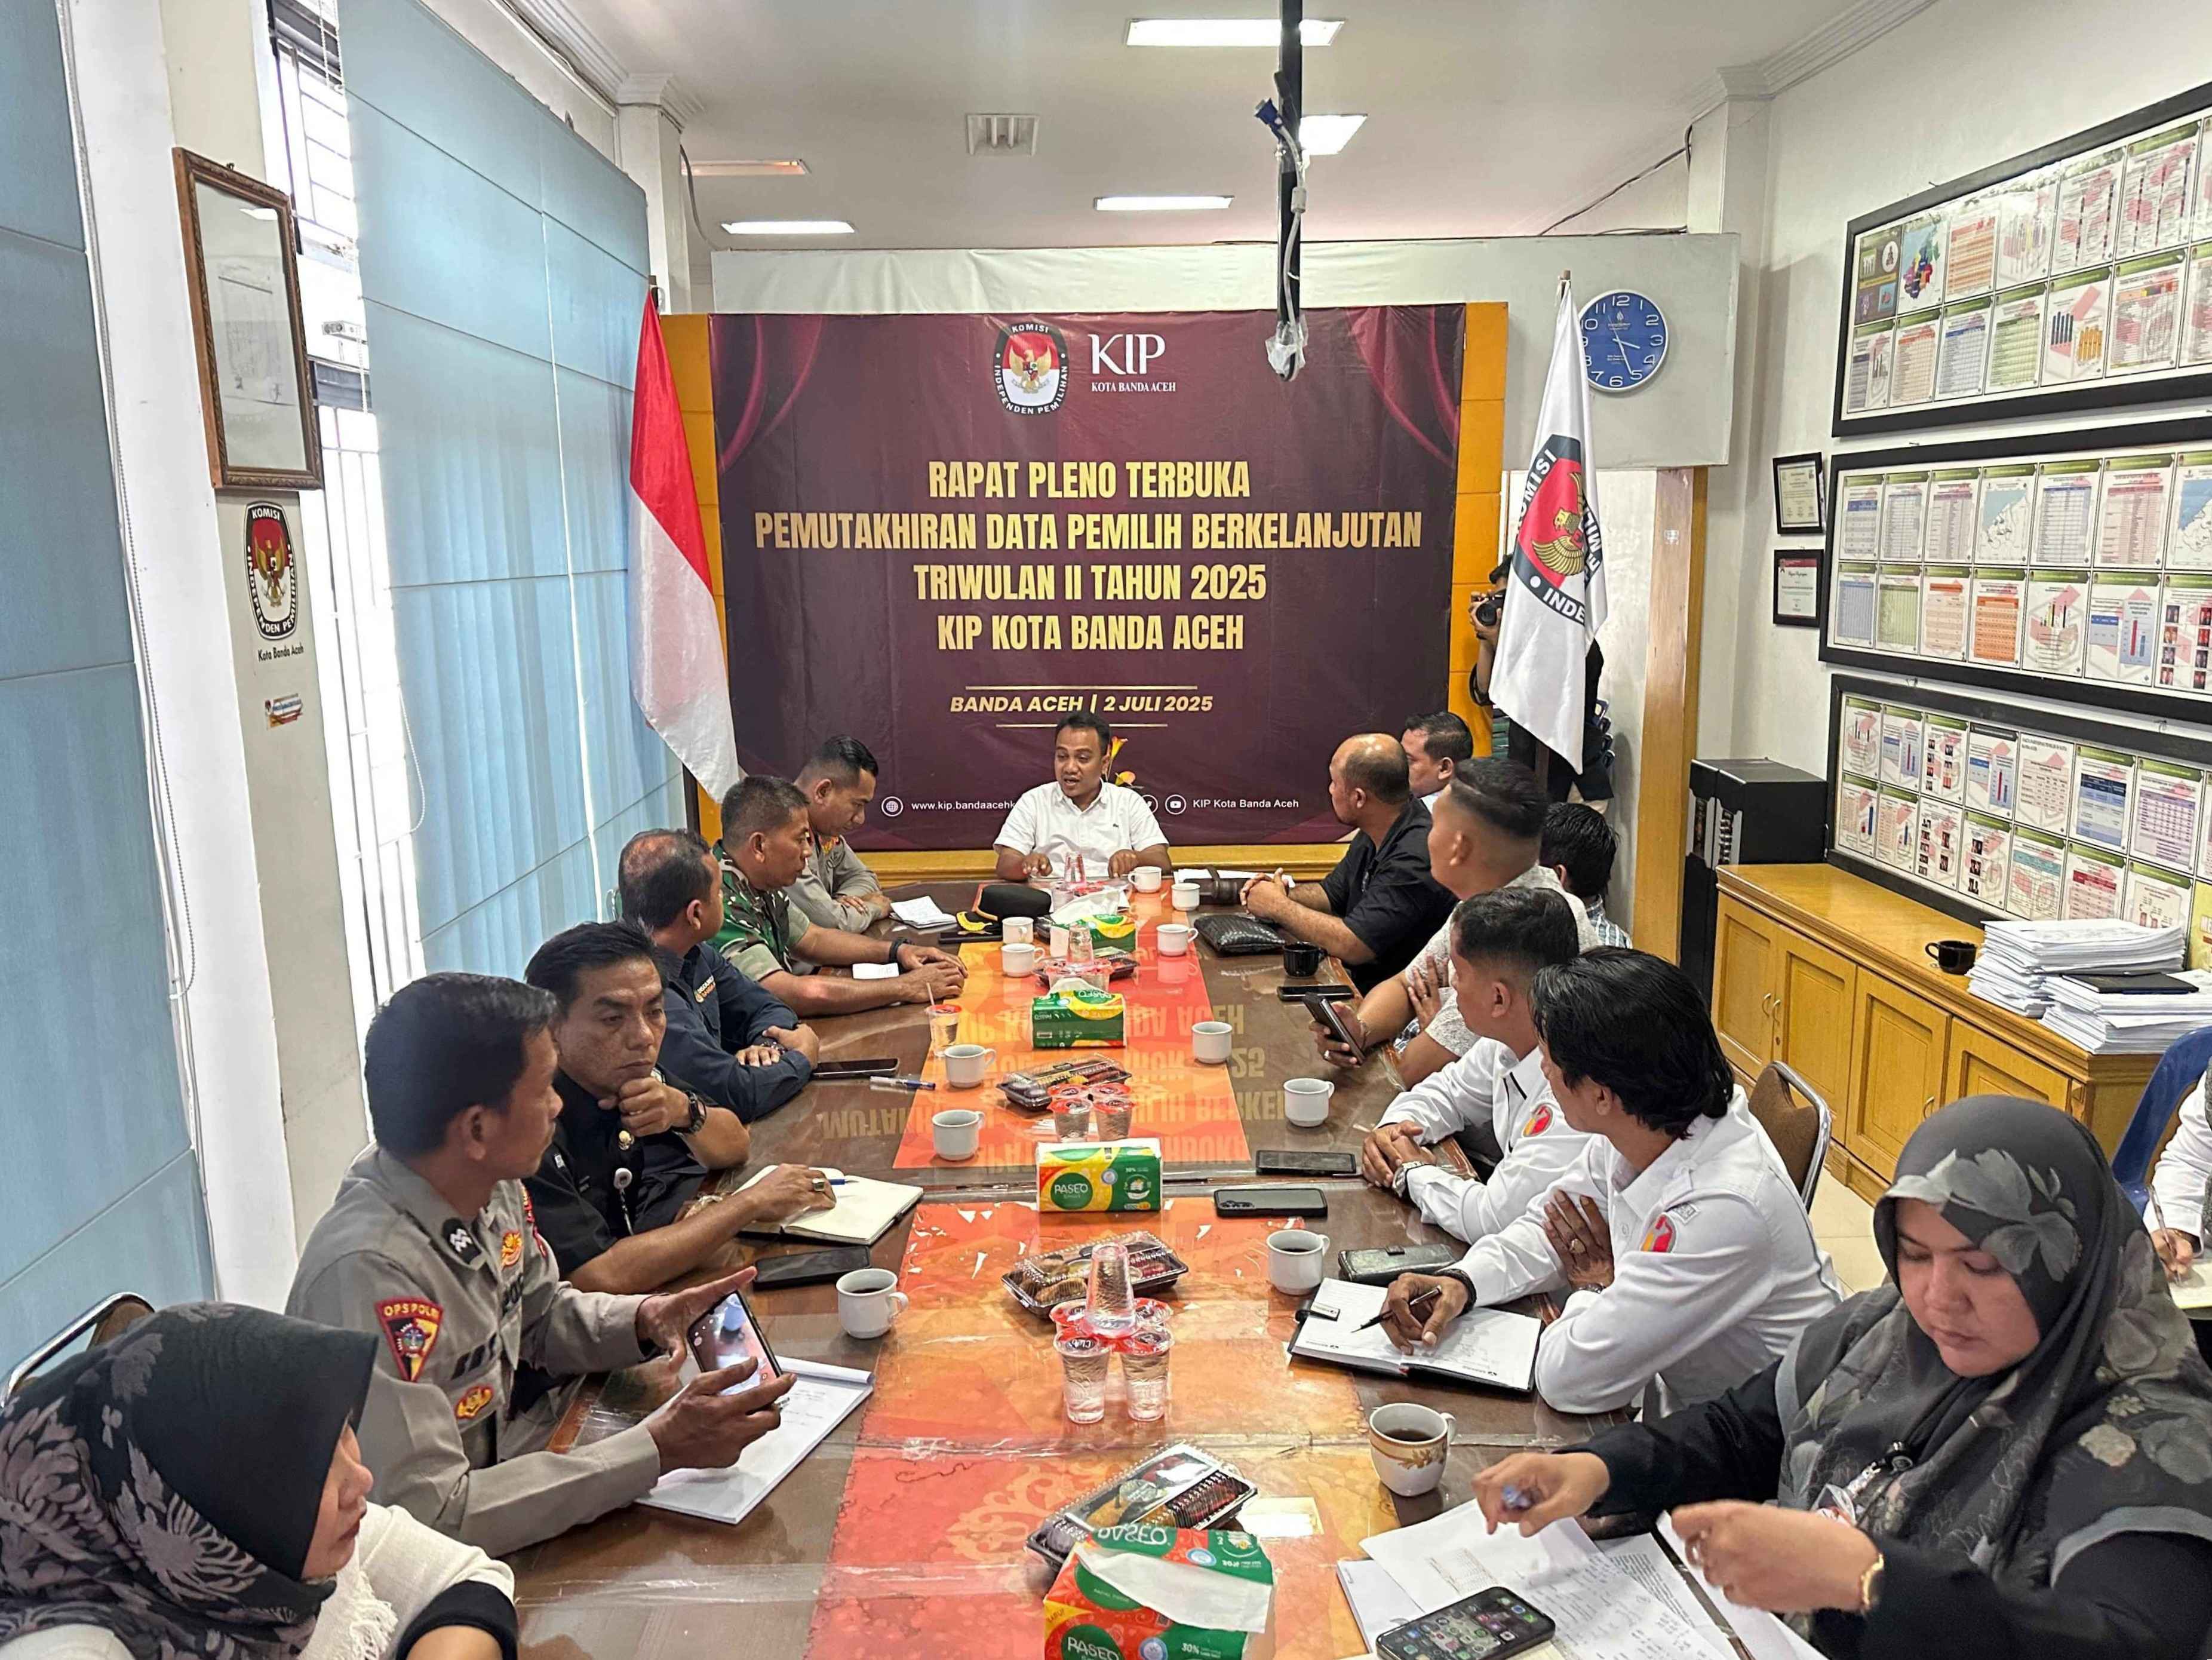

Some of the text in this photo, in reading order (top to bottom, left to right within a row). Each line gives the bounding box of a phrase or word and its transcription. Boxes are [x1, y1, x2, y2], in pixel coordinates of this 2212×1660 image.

[1612, 295, 1630, 306] 12
[1645, 314, 1659, 325] 2
[1012, 324, 1049, 333] KOMISI
[1650, 335, 1663, 346] 3
[1087, 334, 1166, 375] KIP
[1643, 354, 1655, 365] 4
[1591, 371, 1604, 382] 7
[1609, 376, 1623, 386] 6
[1630, 370, 1642, 380] 5
[994, 364, 1068, 415] INDEPENDEN PEMILIHAN
[1091, 382, 1176, 392] KOTA BANDA ACEH
[929, 461, 1250, 498] RAPAT PLENO TERBUKA
[251, 508, 281, 520] KOMISI
[755, 511, 1422, 550] PEMUTAKHIRAN DATA PEMILIH BERKELANJUTAN
[914, 564, 1266, 600] TRIWULAN II TAHUN 2025
[938, 615, 1244, 650] KIP KOTA BANDA ACEH
[258, 642, 304, 662] Kota Banda Aceh
[950, 696, 1022, 712] BANDA
[1027, 696, 1083, 712] ACEH
[1104, 696, 1116, 712] 2
[1119, 696, 1161, 711] JULI
[1164, 695, 1213, 711] 2025
[1193, 799, 1299, 808] KIP Kota Banda Aceh
[1054, 1183, 1089, 1195] PASEO
[1067, 1636, 1120, 1660] PASEO
